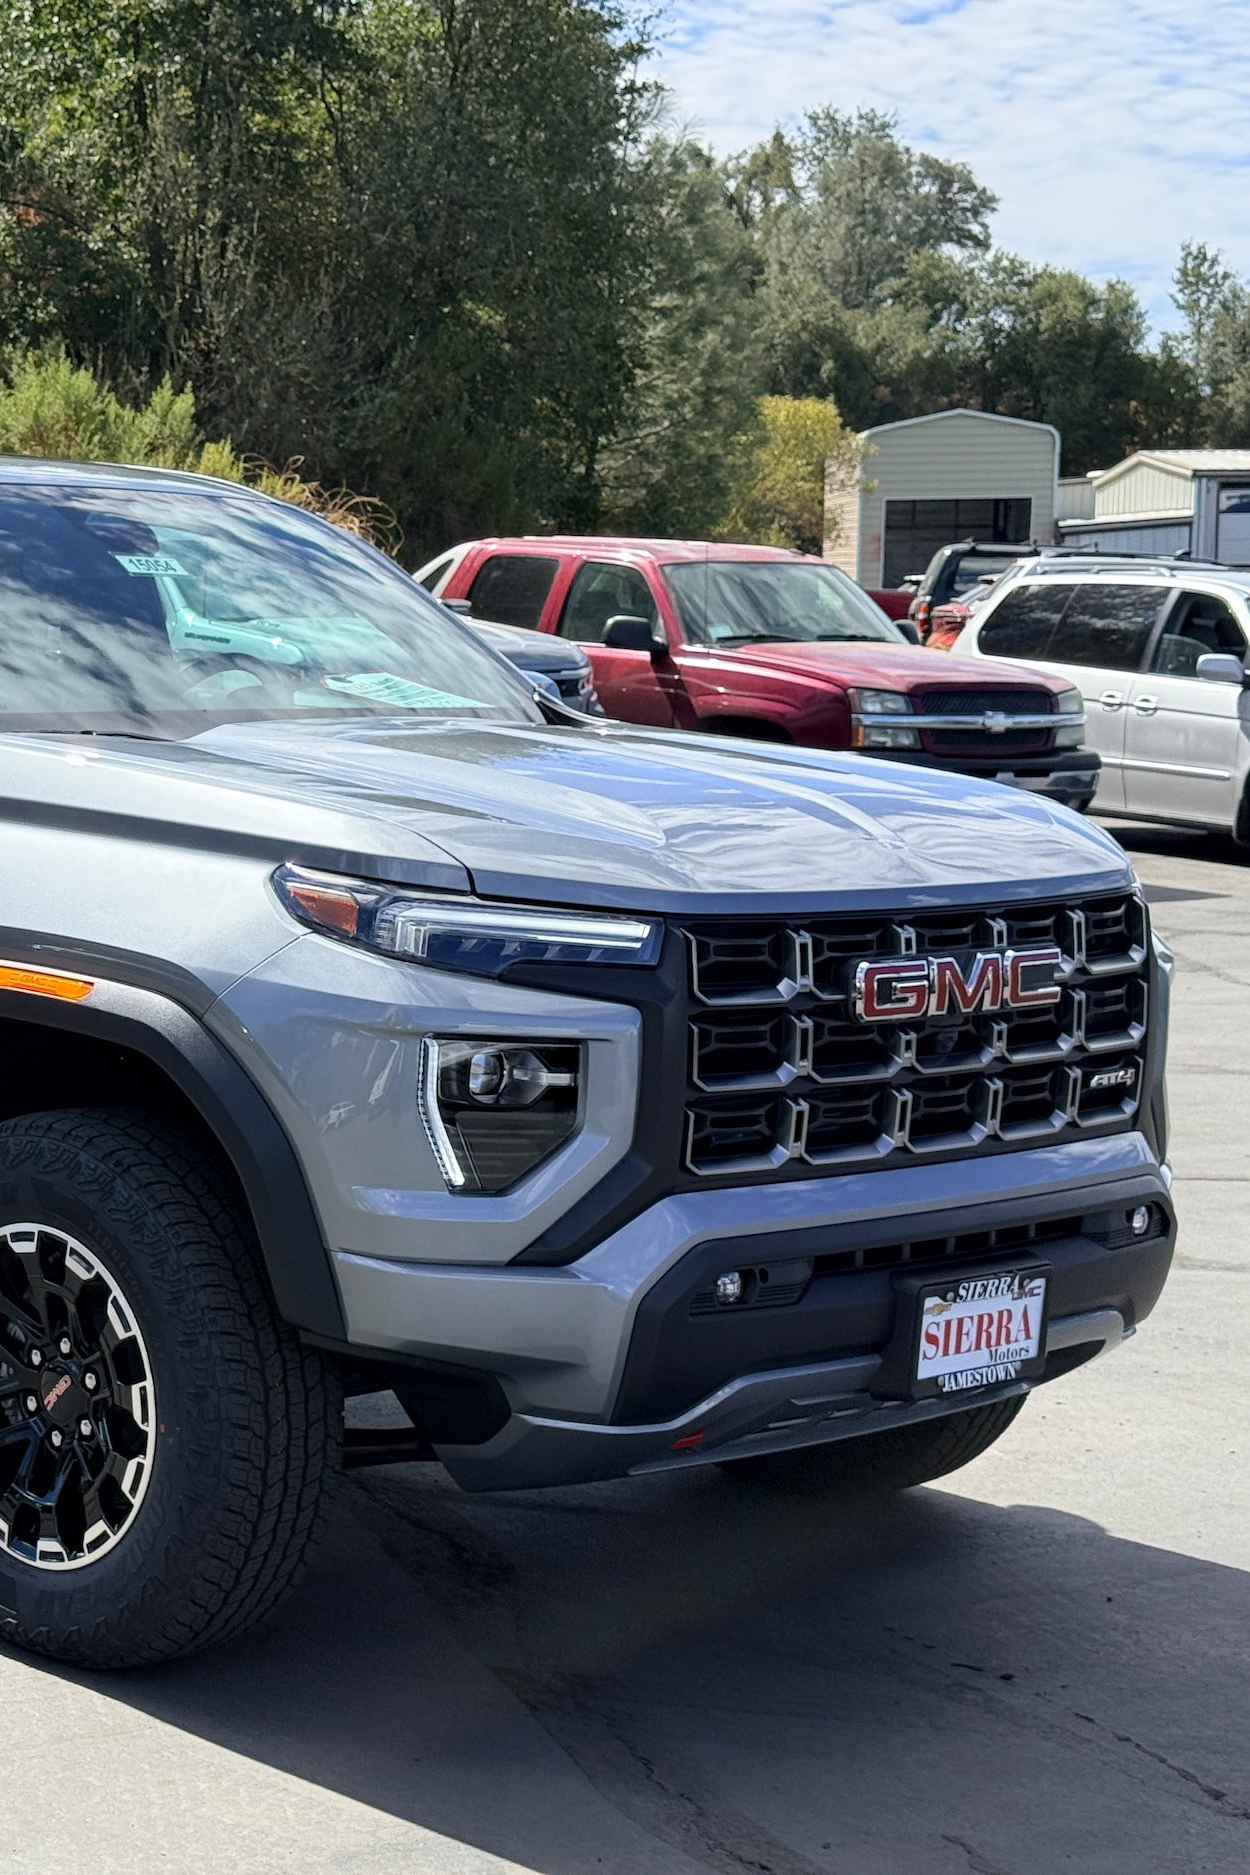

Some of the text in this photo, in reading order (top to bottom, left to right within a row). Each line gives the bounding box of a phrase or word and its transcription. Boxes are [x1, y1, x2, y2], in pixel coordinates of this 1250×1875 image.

[129, 558, 177, 573] 15054
[21, 975, 48, 986] GMC
[856, 948, 1061, 1022] GMC
[1090, 1068, 1135, 1087] AT4
[956, 1274, 1020, 1303] SIERRA
[922, 1304, 1032, 1361] SIERRA
[987, 1345, 1030, 1364] Motors
[942, 1361, 1016, 1392] JAMESTOWN
[44, 1375, 71, 1411] GMC
